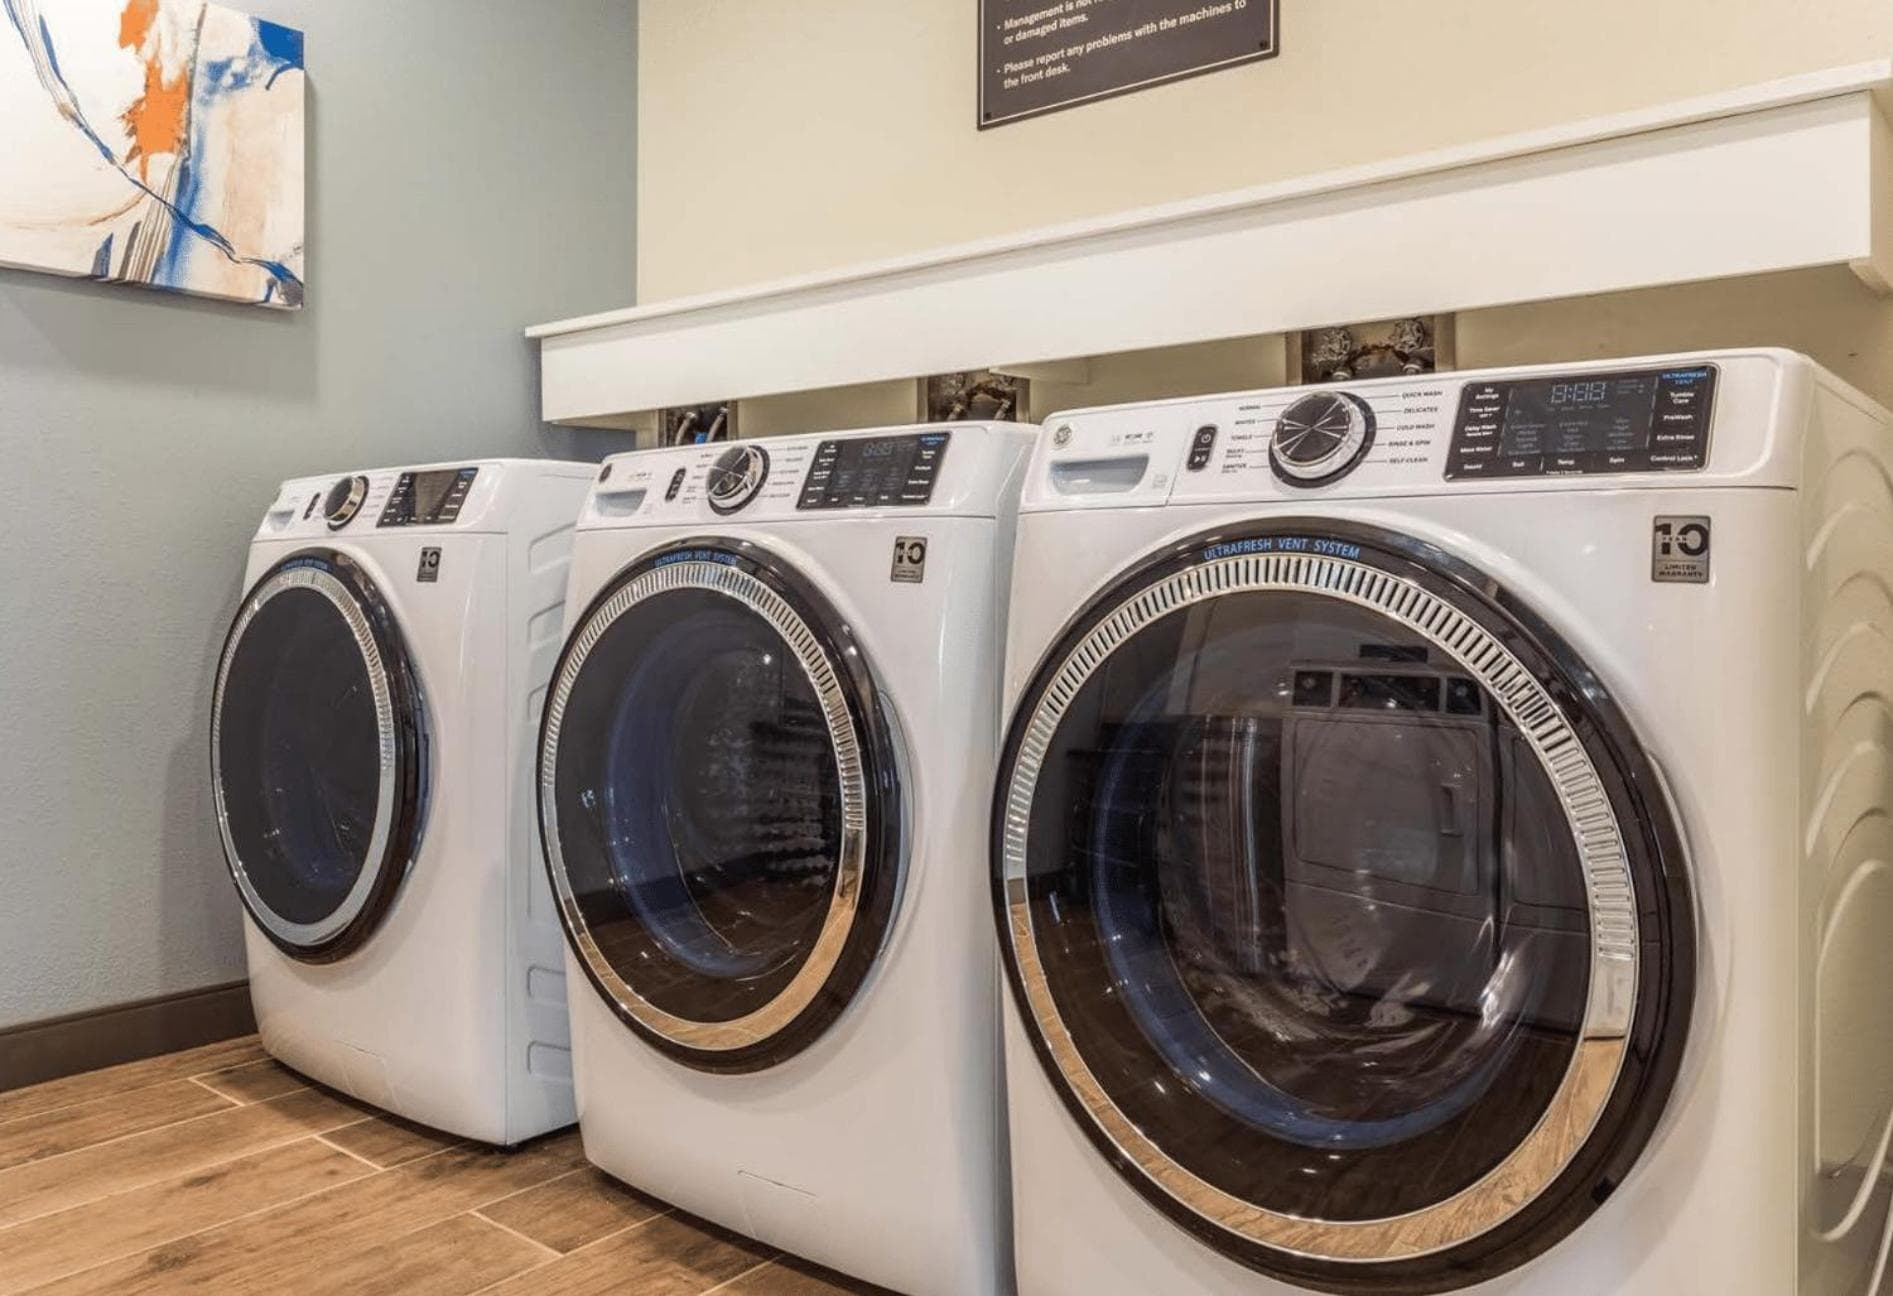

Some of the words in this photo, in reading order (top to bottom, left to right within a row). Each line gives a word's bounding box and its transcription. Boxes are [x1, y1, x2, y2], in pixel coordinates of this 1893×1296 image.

[1004, 4, 1063, 30] Management
[1065, 1, 1074, 12] is
[1004, 35, 1014, 45] or
[1015, 19, 1058, 42] damaged
[1059, 13, 1089, 29] items.
[1004, 58, 1035, 74] Please
[1036, 48, 1065, 66] report
[1067, 45, 1085, 57] any
[1086, 32, 1133, 53] problems
[1135, 21, 1158, 37] with
[1159, 17, 1177, 31] the
[1179, 2, 1232, 25] machines
[1235, 0, 1247, 10] to
[1004, 78, 1019, 89] the
[1020, 70, 1044, 84] front
[1204, 539, 1271, 560] ULTRAFRESH
[1277, 537, 1309, 550] VENT
[1313, 538, 1361, 559] SYSTEM
